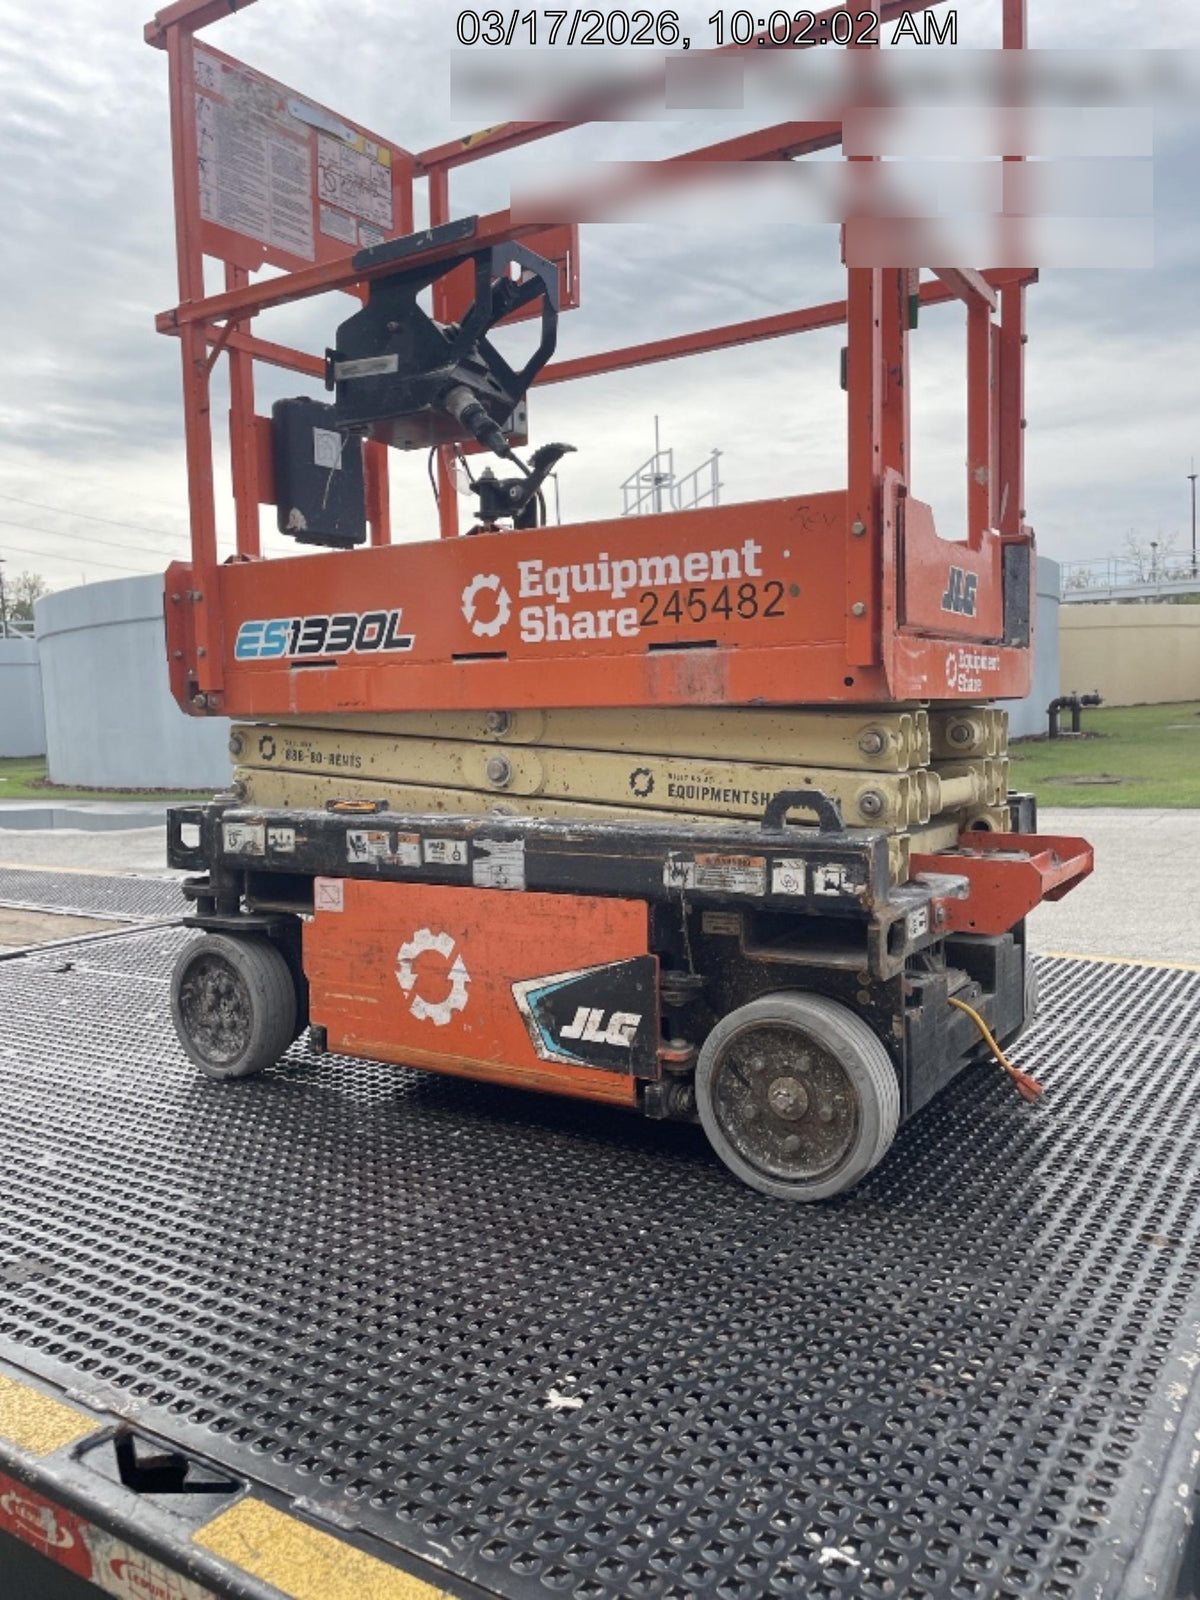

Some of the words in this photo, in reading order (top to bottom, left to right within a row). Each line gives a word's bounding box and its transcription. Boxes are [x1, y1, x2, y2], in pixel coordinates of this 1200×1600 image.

[518, 539, 763, 603] Equipment
[518, 605, 641, 642] Share
[640, 580, 786, 626] 245482
[234, 608, 416, 660] ES1330L
[560, 1006, 642, 1047] JLG
